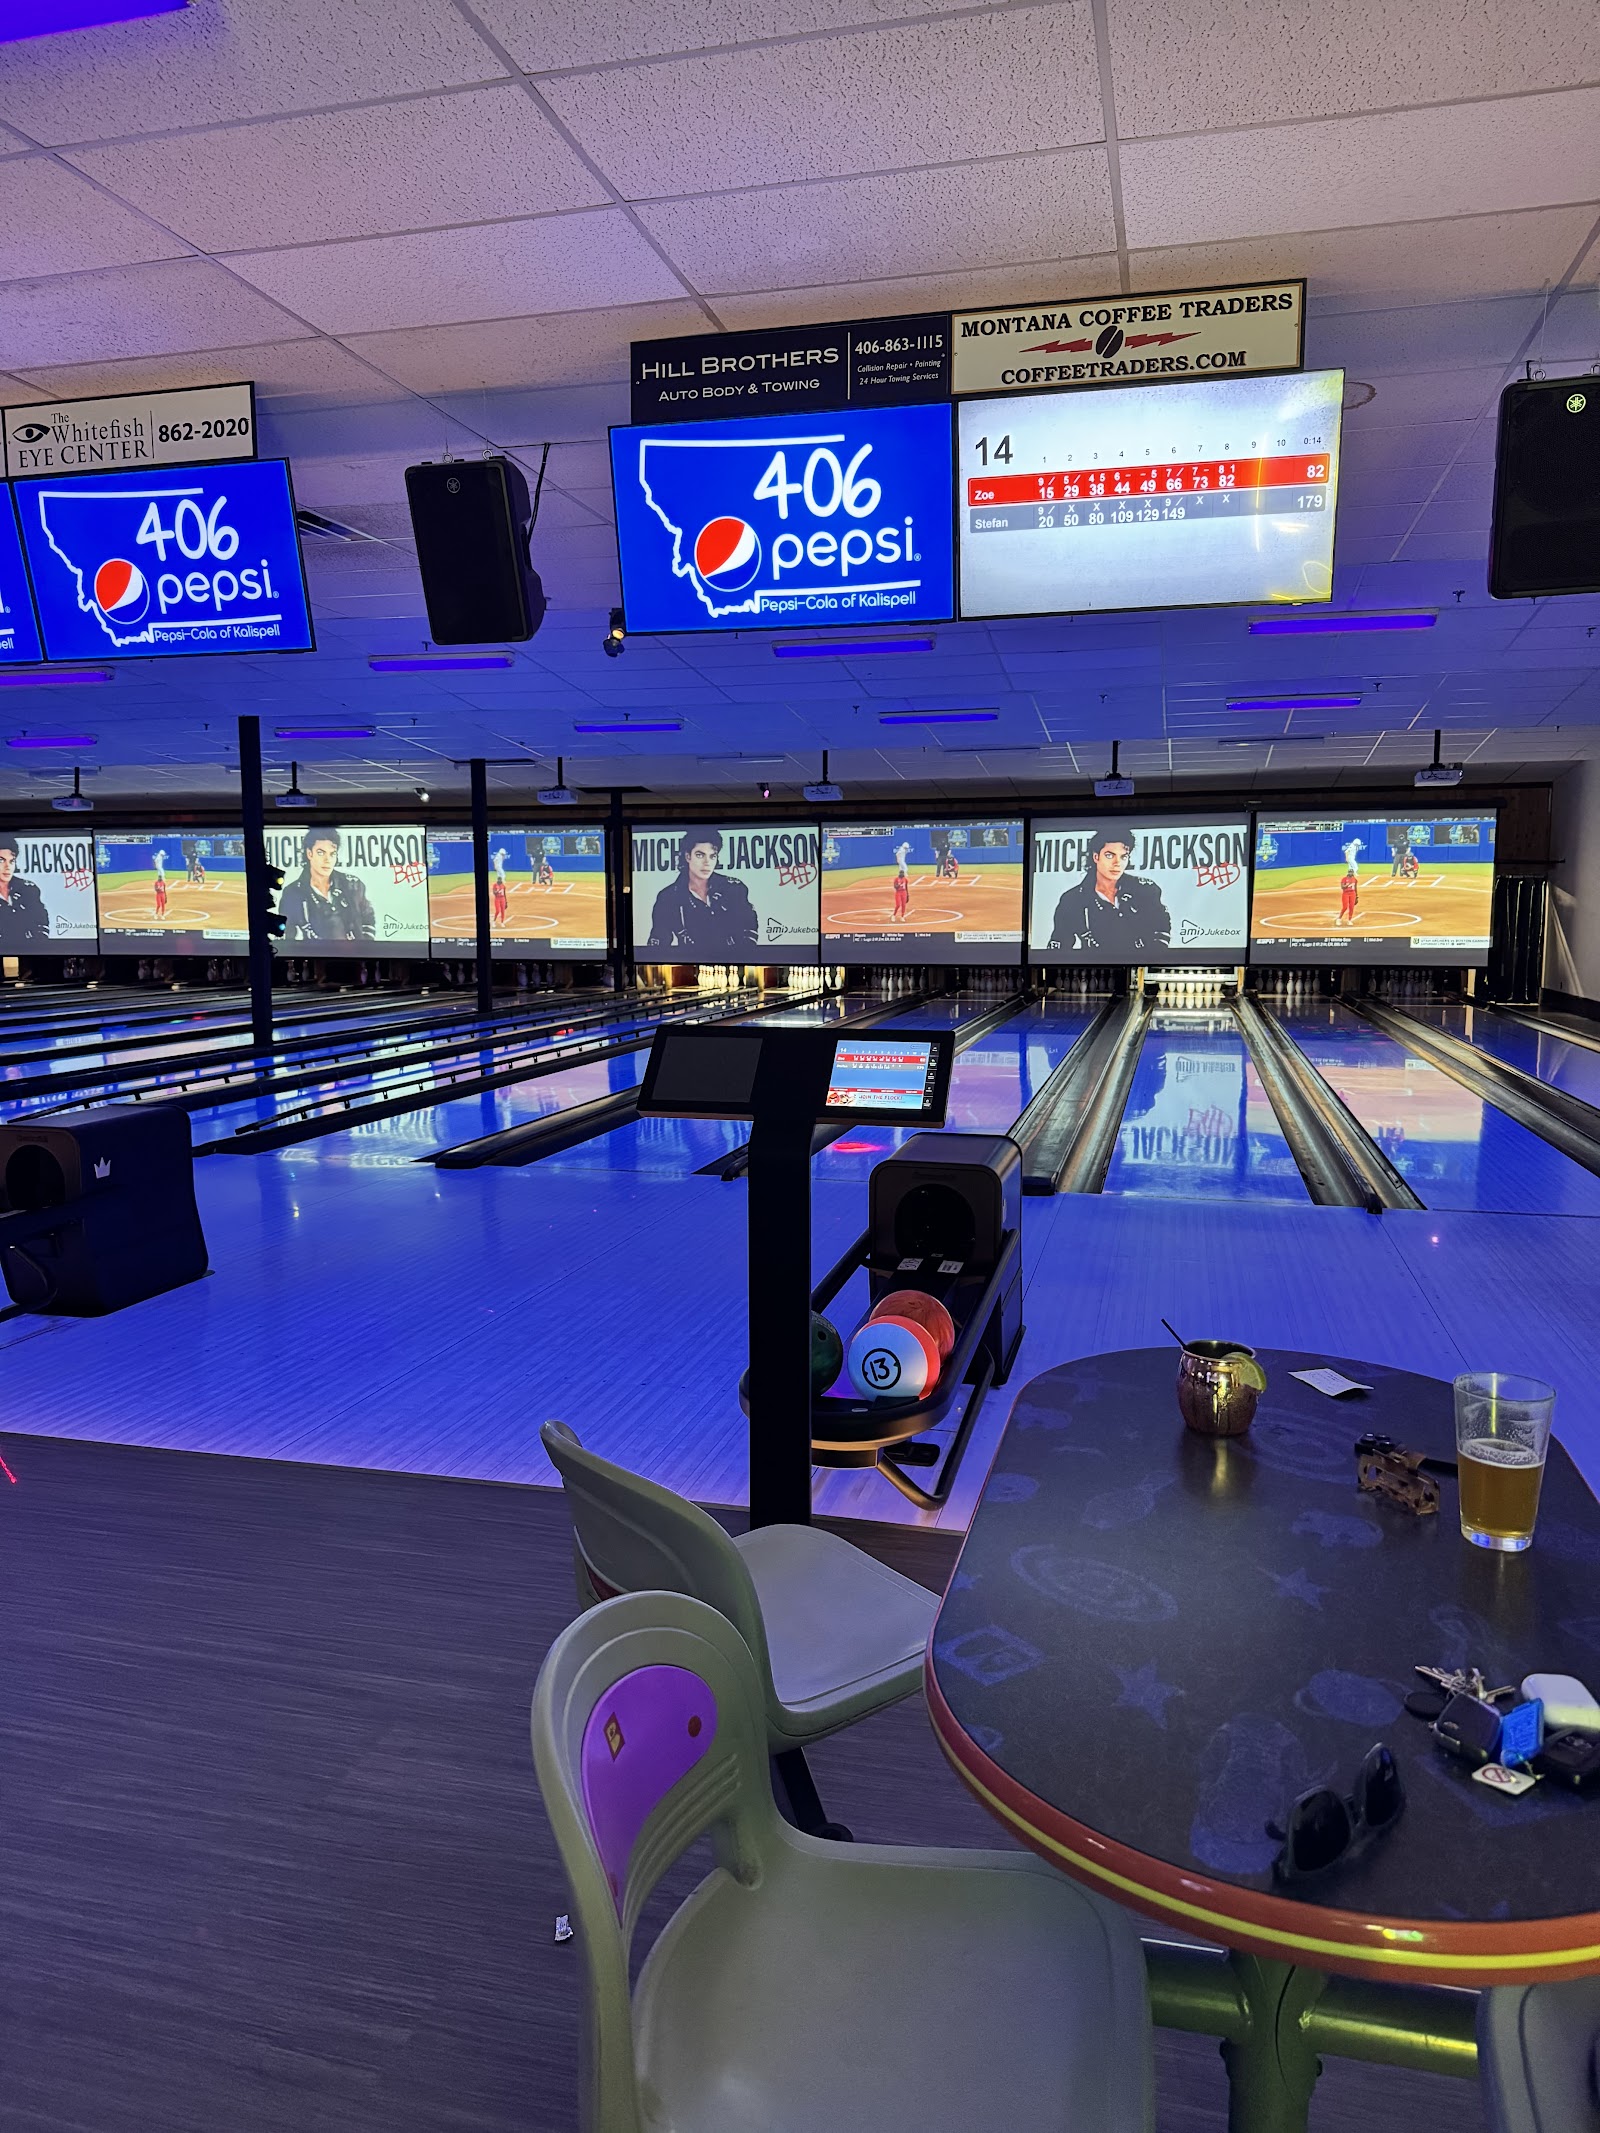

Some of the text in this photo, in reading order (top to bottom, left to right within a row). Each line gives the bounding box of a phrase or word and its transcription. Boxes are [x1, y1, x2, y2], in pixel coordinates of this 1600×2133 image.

[961, 292, 1293, 338] MONTANA COFFEE TRADERS
[855, 334, 943, 355] 406-863-1115
[642, 347, 839, 380] HILL BROTHERS
[857, 360, 941, 373] Collision Repair Painting
[1001, 350, 1247, 385] COFFEETRADERS.COM
[658, 378, 820, 402] AUTO BODY & TOWING
[859, 372, 939, 385] 24 Hour Towing Services
[51, 412, 70, 424] The
[51, 418, 144, 444] Whitefish
[158, 417, 249, 443] 862-2020
[19, 440, 149, 469] EYE CENTER
[975, 435, 1013, 466] 14
[1277, 439, 1286, 447] 10
[1303, 437, 1322, 445] 0:14
[753, 443, 882, 520] 406
[974, 465, 1324, 500] Zoe 15 29 38 44 49 66 73 82 82
[975, 495, 1323, 529] Stefan 20 50 80 109 129 149 179
[136, 495, 239, 562] 406
[772, 516, 914, 580] pepsi
[157, 558, 273, 614] pepsi
[761, 591, 916, 614] Pepsi-Cola of Kalispell
[154, 625, 280, 643] Pepsi-Cola of Kalispell
[1140, 832, 1247, 870] JACKSON
[775, 862, 818, 889] BAD
[1192, 861, 1241, 890] BAD
[1205, 927, 1241, 936] Jukebox
[869, 1357, 890, 1382] 13
